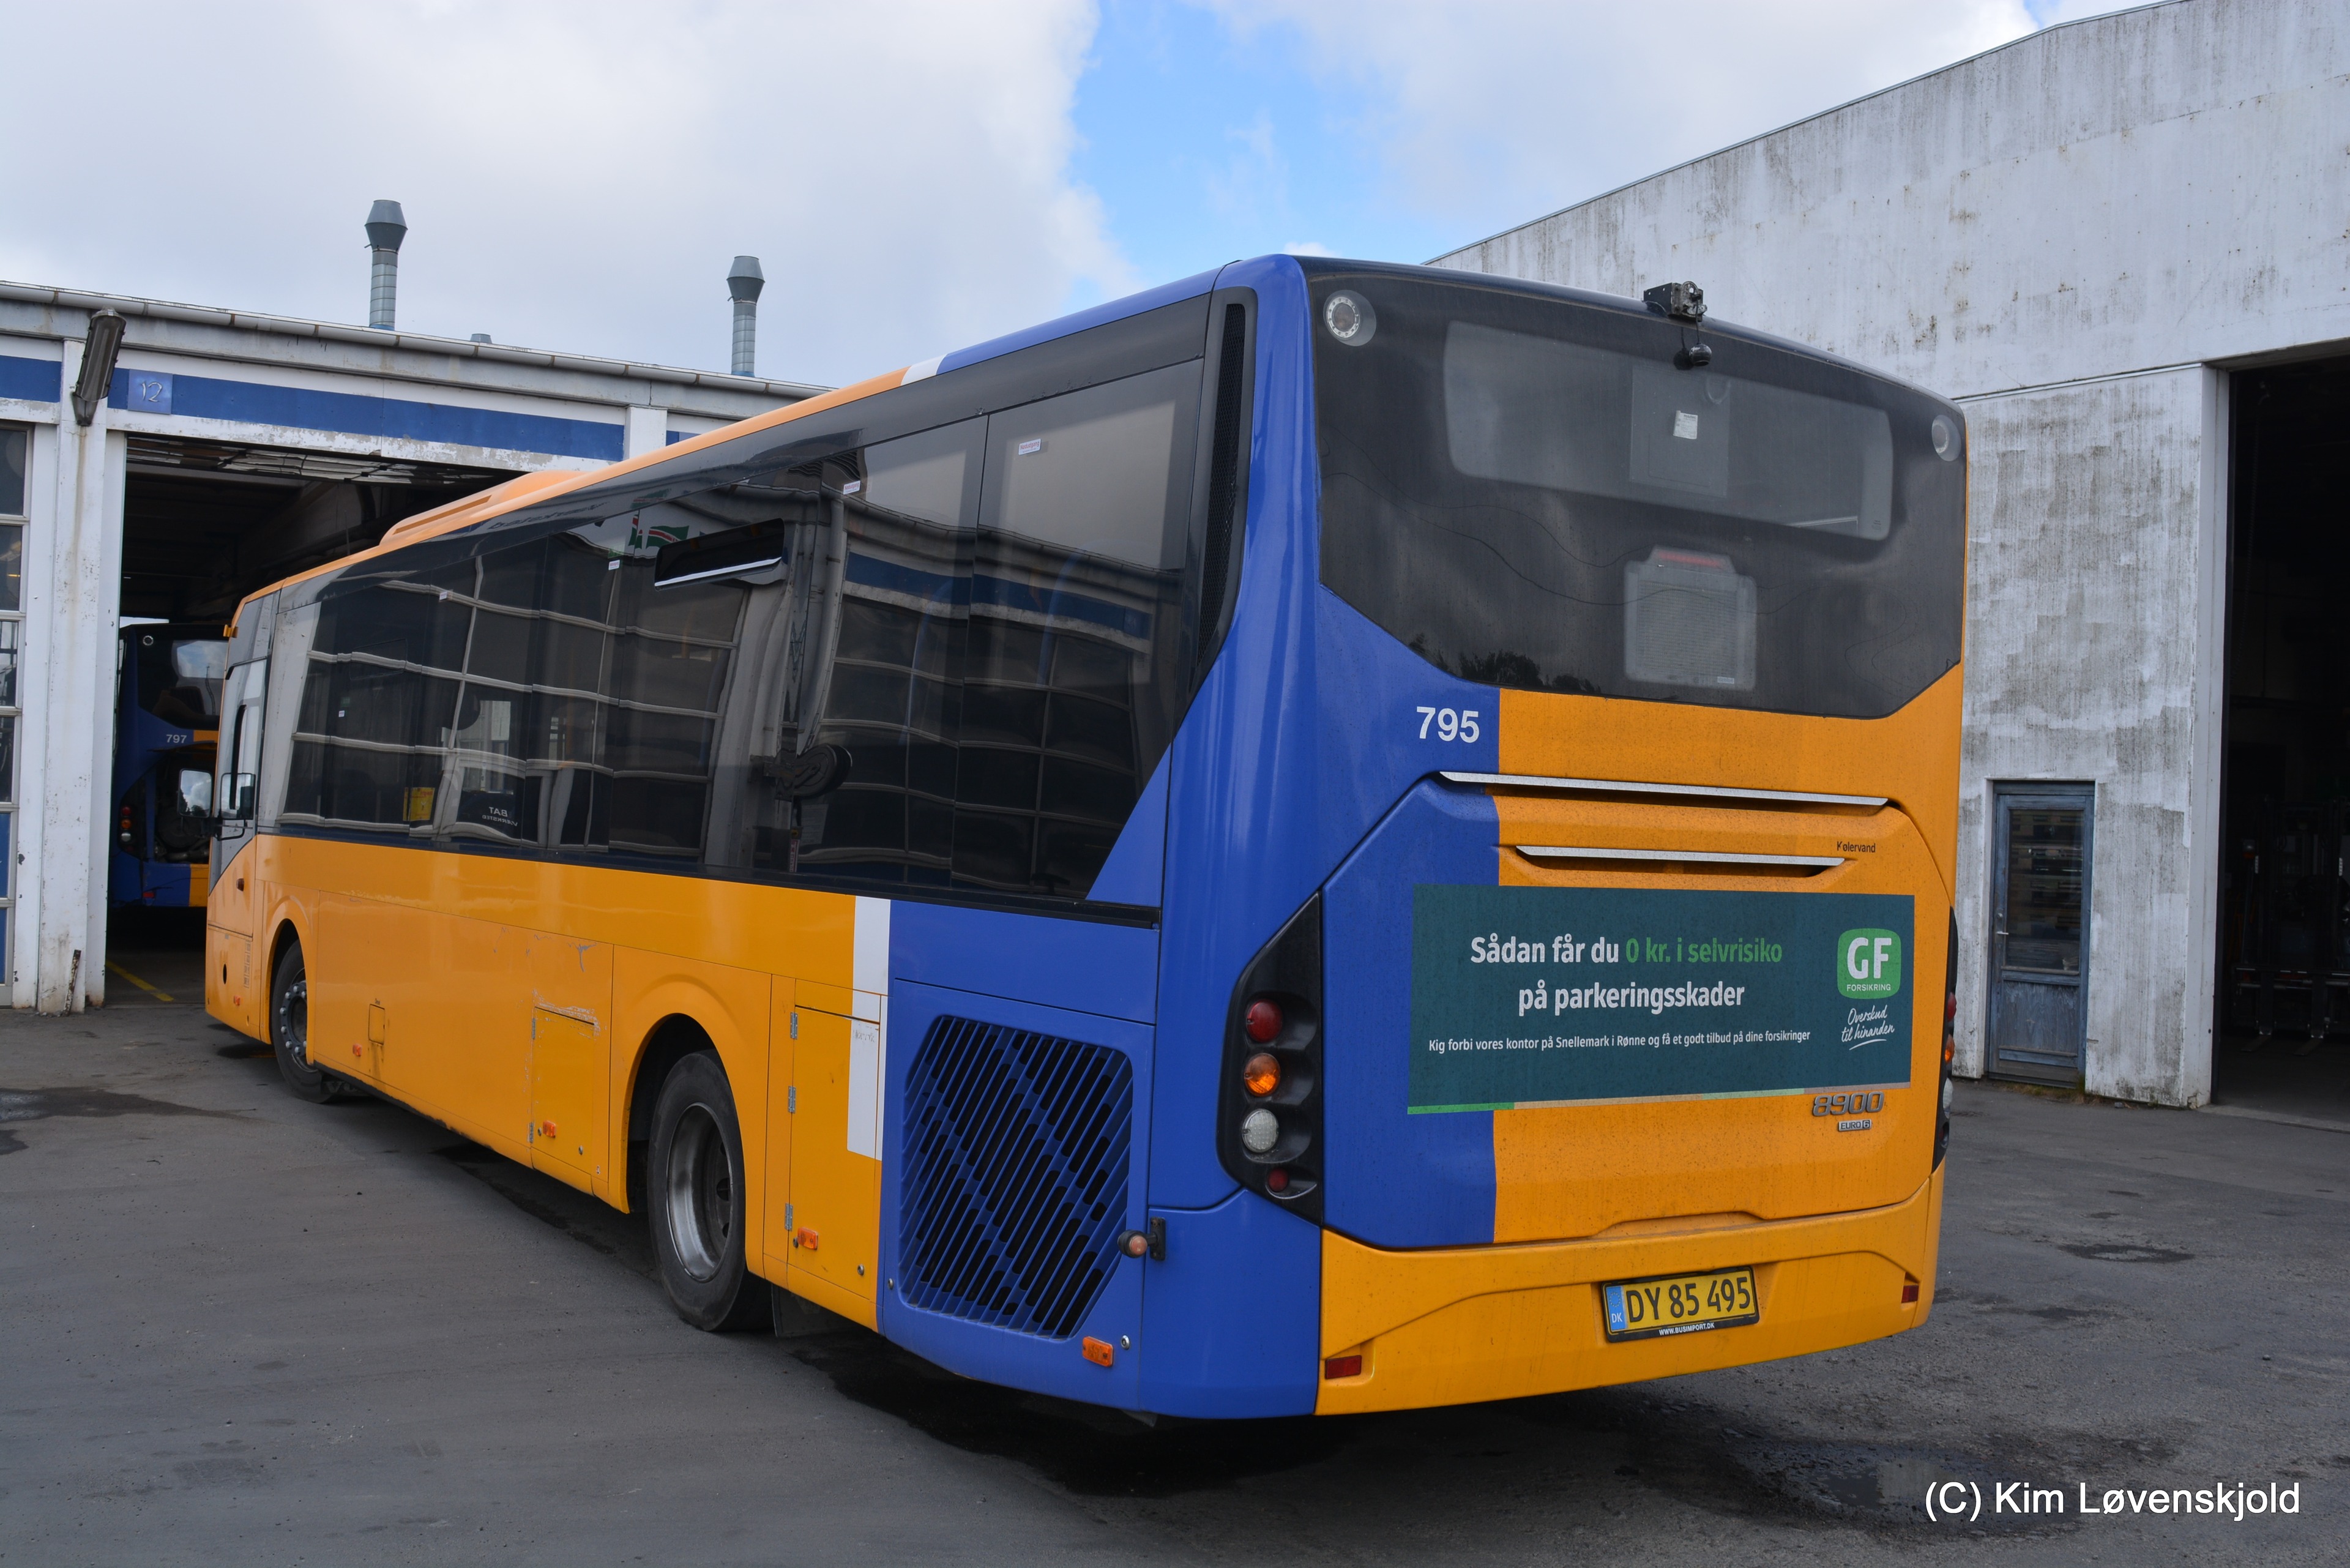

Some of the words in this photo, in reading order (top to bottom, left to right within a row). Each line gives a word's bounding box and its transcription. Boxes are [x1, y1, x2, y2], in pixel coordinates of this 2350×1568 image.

[141, 381, 162, 402] 12
[1416, 706, 1480, 743] 795
[166, 734, 187, 743] 797
[1837, 841, 1876, 853] Kølervand
[1471, 933, 1545, 963] Sådan
[1552, 933, 1586, 963] får
[1591, 936, 1619, 963] du
[1625, 938, 1639, 963] 0
[1646, 937, 1671, 963] kr.
[1677, 937, 1682, 963] i
[1688, 938, 1782, 963] selvrisiko
[1847, 937, 1892, 979] GF
[1519, 979, 1547, 1017] på
[1554, 980, 1745, 1016] parkeringsskader
[1848, 1004, 1887, 1025] Overskud
[1429, 1040, 1445, 1054] Kig
[1449, 1039, 1473, 1051] forbi
[1475, 1040, 1504, 1050] vores
[1506, 1038, 1539, 1050] kontor
[1542, 1036, 1554, 1051] på
[1556, 1036, 1610, 1048] Snellemark
[1611, 1036, 1614, 1047] i
[1617, 1035, 1646, 1047] Rønne
[1647, 1037, 1660, 1048] og
[1662, 1032, 1671, 1045] få
[1673, 1034, 1682, 1045] et
[1684, 1033, 1705, 1047] godt
[1706, 1032, 1731, 1044] tilbud
[1733, 1031, 1744, 1045] på
[1745, 1031, 1763, 1042] dine
[1765, 1029, 1811, 1043] forsikringer
[1841, 1026, 1853, 1042] til
[1854, 1020, 1895, 1040] hinanden
[1813, 1091, 1884, 1116] 8900
[1840, 1121, 1861, 1130] EURO
[1862, 1120, 1870, 1129] 6
[1611, 1313, 1622, 1323] DK
[1626, 1287, 1660, 1323] DY
[1668, 1283, 1699, 1318] 85
[1707, 1277, 1750, 1312] 495
[1658, 1322, 1715, 1336] WWW.BUSIMPORT.DK
